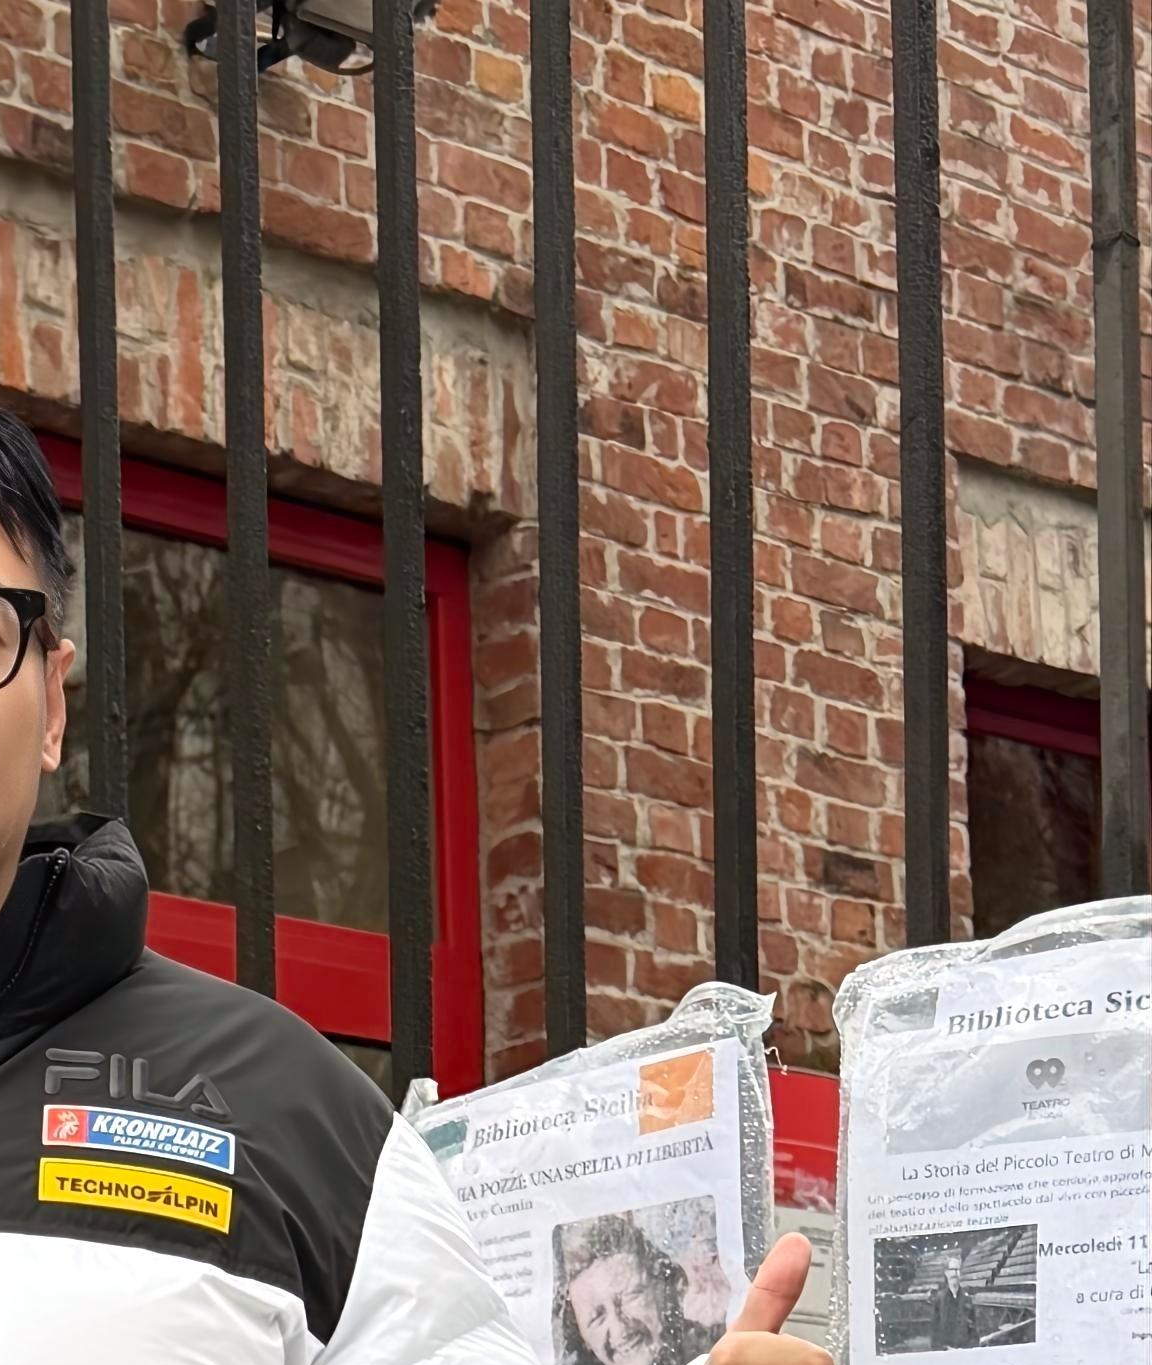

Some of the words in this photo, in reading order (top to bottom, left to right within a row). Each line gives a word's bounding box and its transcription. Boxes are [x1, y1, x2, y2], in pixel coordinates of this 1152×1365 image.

[948, 998, 1093, 1036] Biblioteca
[44, 1047, 232, 1123] FILA
[92, 1114, 226, 1154] KRONPLATZ
[471, 1110, 577, 1150] Biblioteca
[563, 1155, 622, 1180] SCELTA
[625, 1149, 643, 1168] DI
[647, 1131, 714, 1163] LIBERTÀ
[902, 1165, 918, 1181] La
[924, 1163, 969, 1179] Storia
[1004, 1152, 1059, 1170] Piccolo
[1064, 1149, 1114, 1165] Teatro
[1120, 1144, 1135, 1160] di
[55, 1176, 219, 1218] TECHNOALPIN
[1038, 1235, 1123, 1257] Mercoledì
[1076, 1292, 1084, 1304] a
[1090, 1290, 1124, 1303] cura
[1129, 1284, 1144, 1300] di
